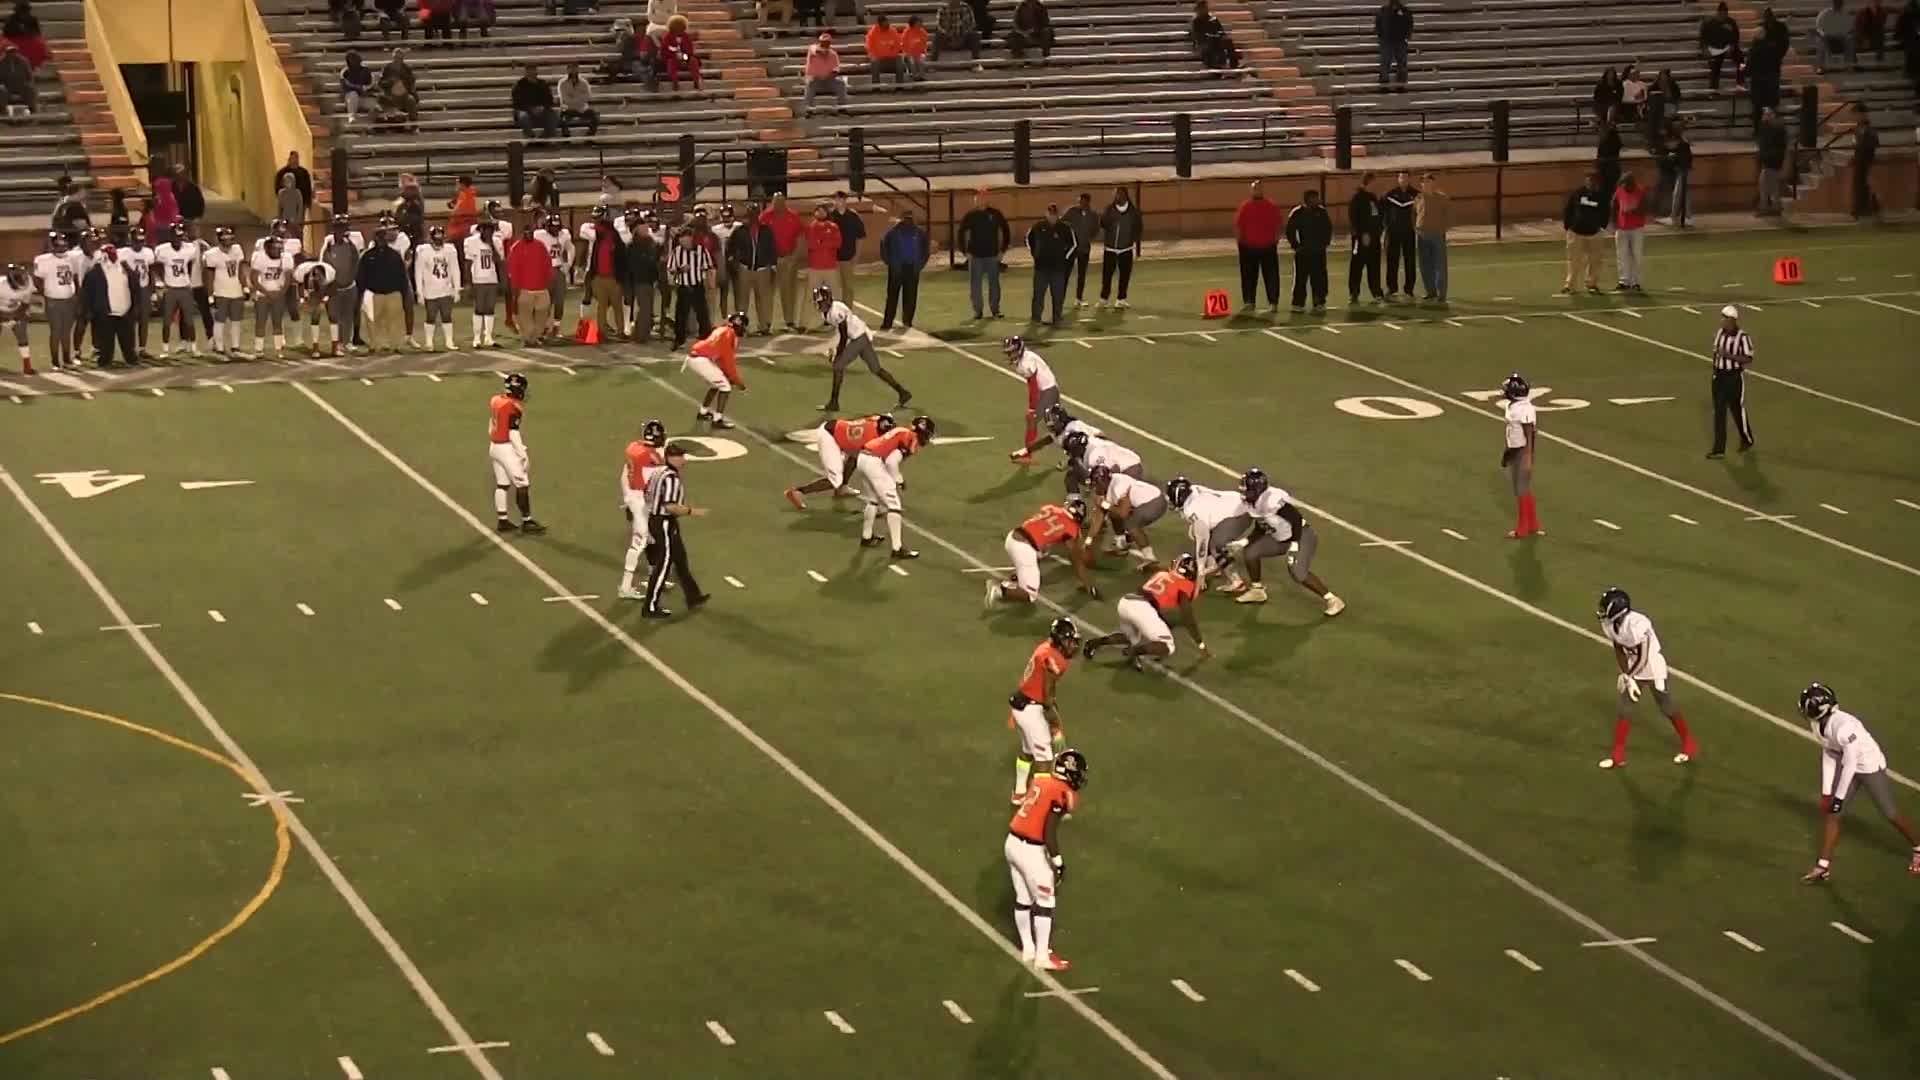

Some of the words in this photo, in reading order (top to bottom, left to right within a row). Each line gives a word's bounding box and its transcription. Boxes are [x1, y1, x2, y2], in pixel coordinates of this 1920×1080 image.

[660, 175, 681, 202] 3
[1780, 262, 1798, 279] 10
[1209, 294, 1229, 313] 20
